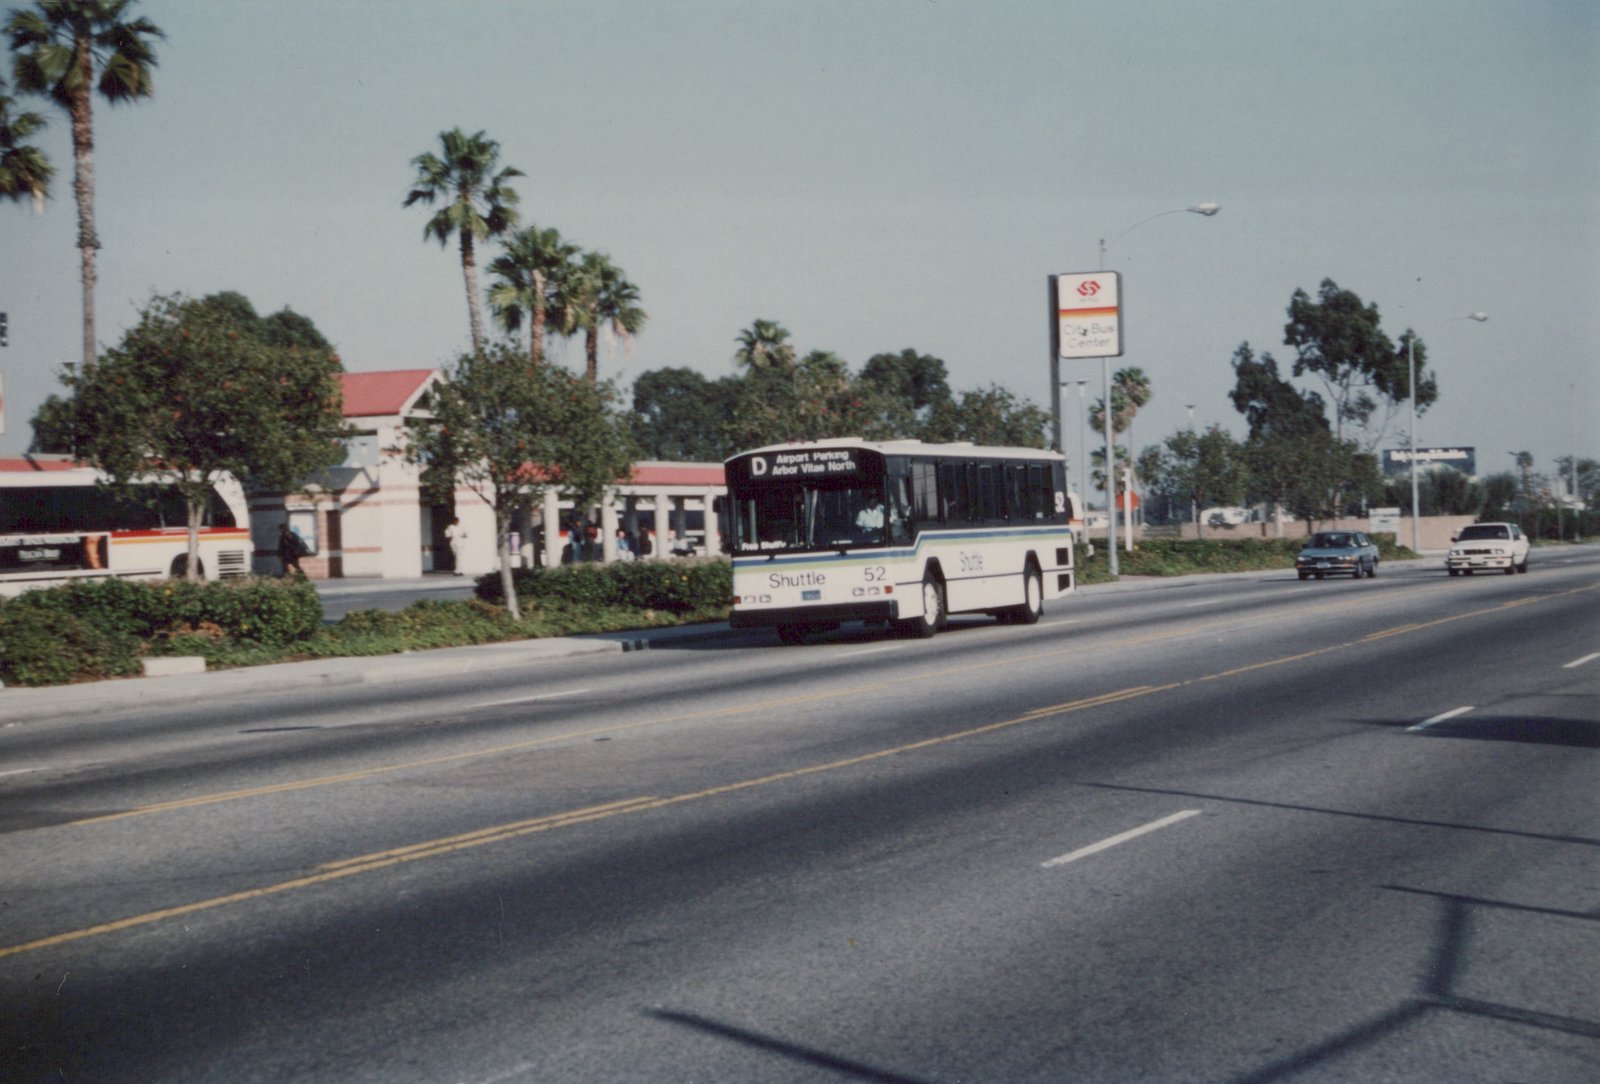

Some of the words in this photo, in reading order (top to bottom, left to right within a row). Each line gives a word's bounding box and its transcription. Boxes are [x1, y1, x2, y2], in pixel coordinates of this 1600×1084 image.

[1091, 323, 1114, 334] Bus
[1067, 338, 1110, 348] Center
[776, 452, 809, 464] Airport
[813, 451, 849, 461] Parking
[752, 457, 767, 476] D
[772, 465, 798, 475] Arbor
[801, 463, 825, 473] Vitae
[828, 461, 855, 471] North
[769, 572, 826, 588] Shuttle
[864, 566, 886, 581] 52
